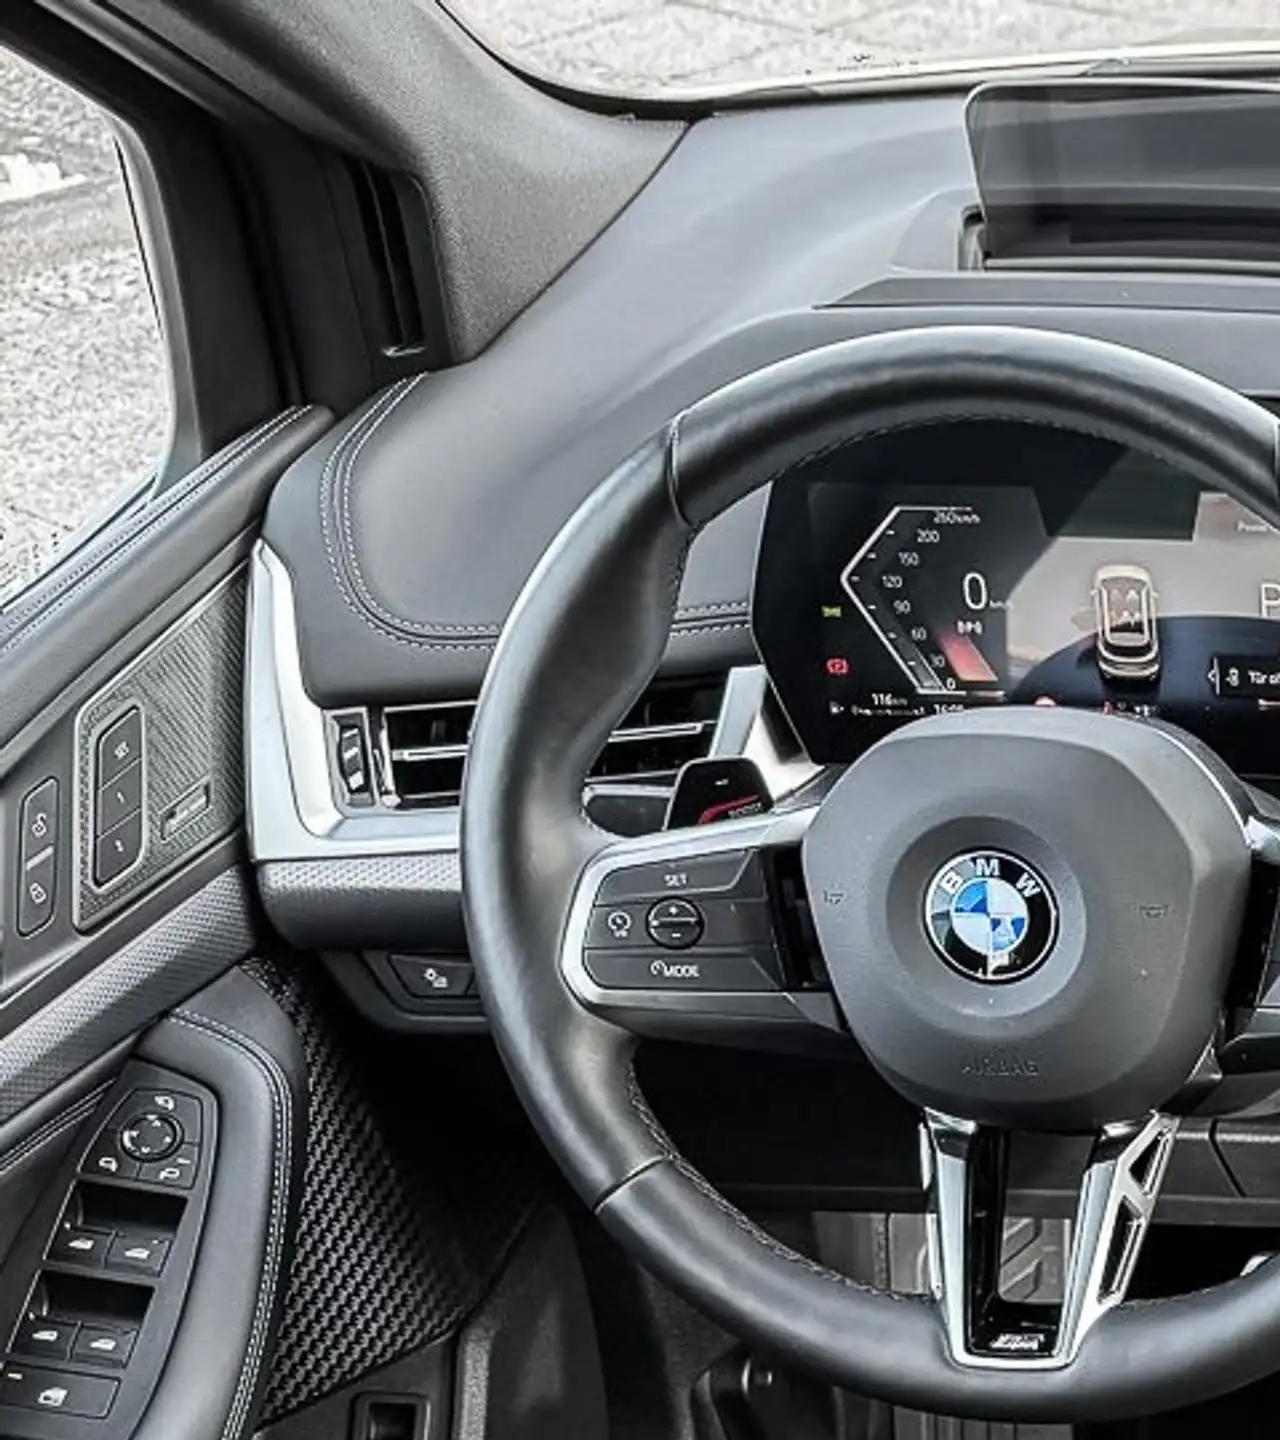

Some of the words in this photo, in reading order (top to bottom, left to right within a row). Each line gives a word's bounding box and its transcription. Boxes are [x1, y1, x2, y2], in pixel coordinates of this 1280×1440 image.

[917, 529, 940, 543] 200
[898, 551, 919, 566] 150
[881, 575, 903, 588] 120
[963, 572, 987, 610] 0
[894, 600, 911, 614] 90
[910, 627, 927, 641] 60
[946, 678, 956, 690] 0
[1249, 670, 1268, 684] Tür
[664, 872, 688, 887] SET
[940, 857, 1041, 898] BMW
